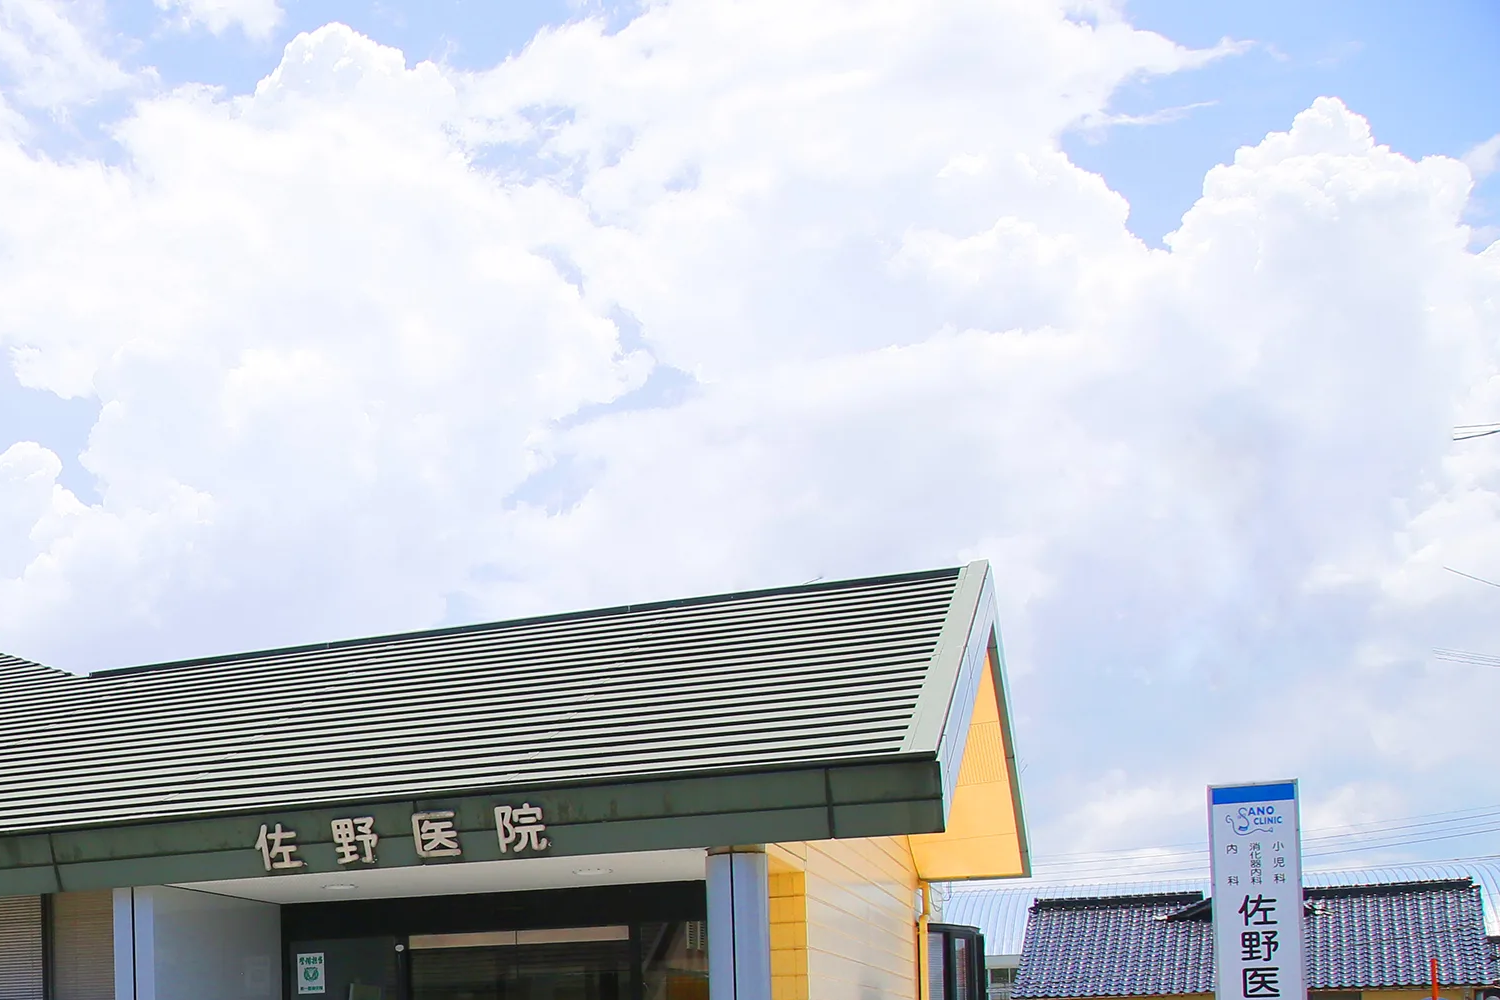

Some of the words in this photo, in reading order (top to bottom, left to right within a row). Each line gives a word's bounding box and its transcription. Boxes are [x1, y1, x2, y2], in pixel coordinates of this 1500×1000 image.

[255, 802, 548, 872] 佐野医院
[1253, 815, 1283, 825] CLINIC
[1226, 844, 1239, 886] 内科
[1249, 842, 1262, 885] 消化器内科
[1272, 841, 1286, 884] 小児科
